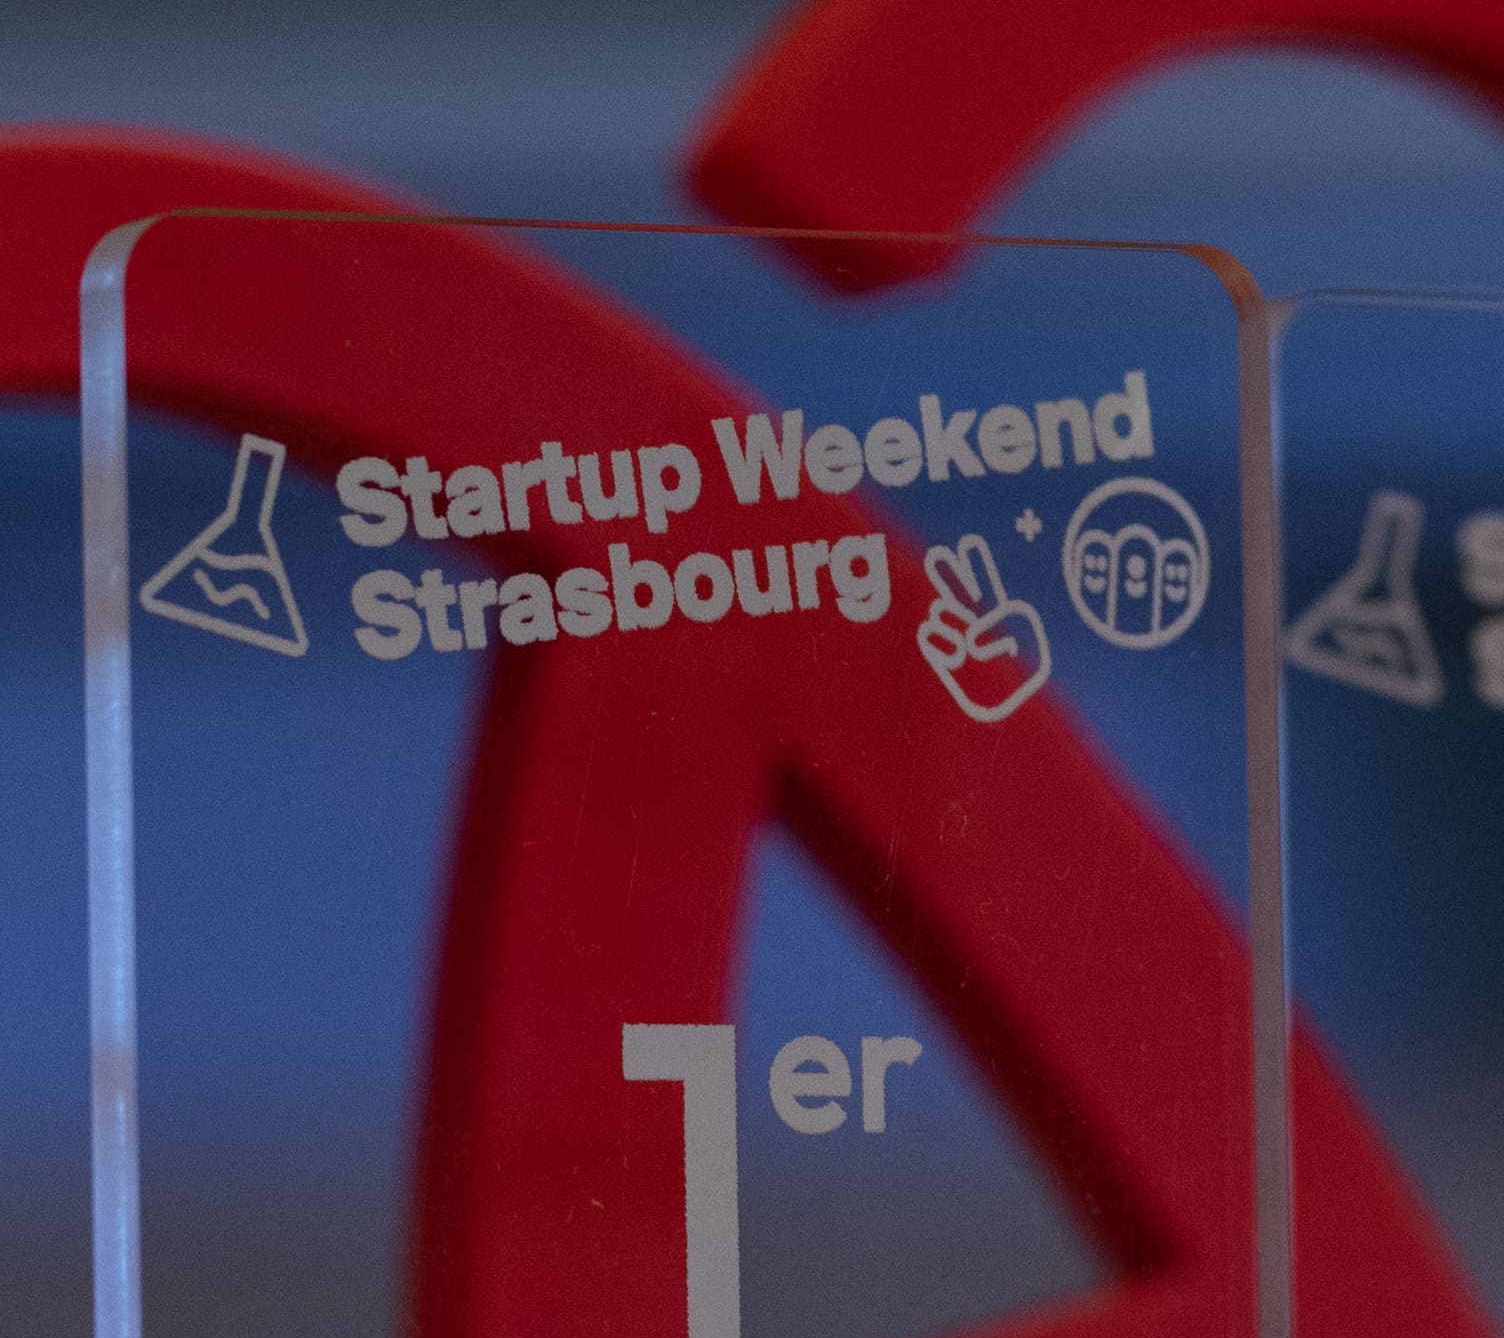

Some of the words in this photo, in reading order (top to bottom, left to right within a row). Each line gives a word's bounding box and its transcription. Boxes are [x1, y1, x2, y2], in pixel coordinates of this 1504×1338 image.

[335, 441, 702, 547] Startup
[712, 371, 1156, 506] Weekend
[350, 534, 893, 660] Strasbourg
